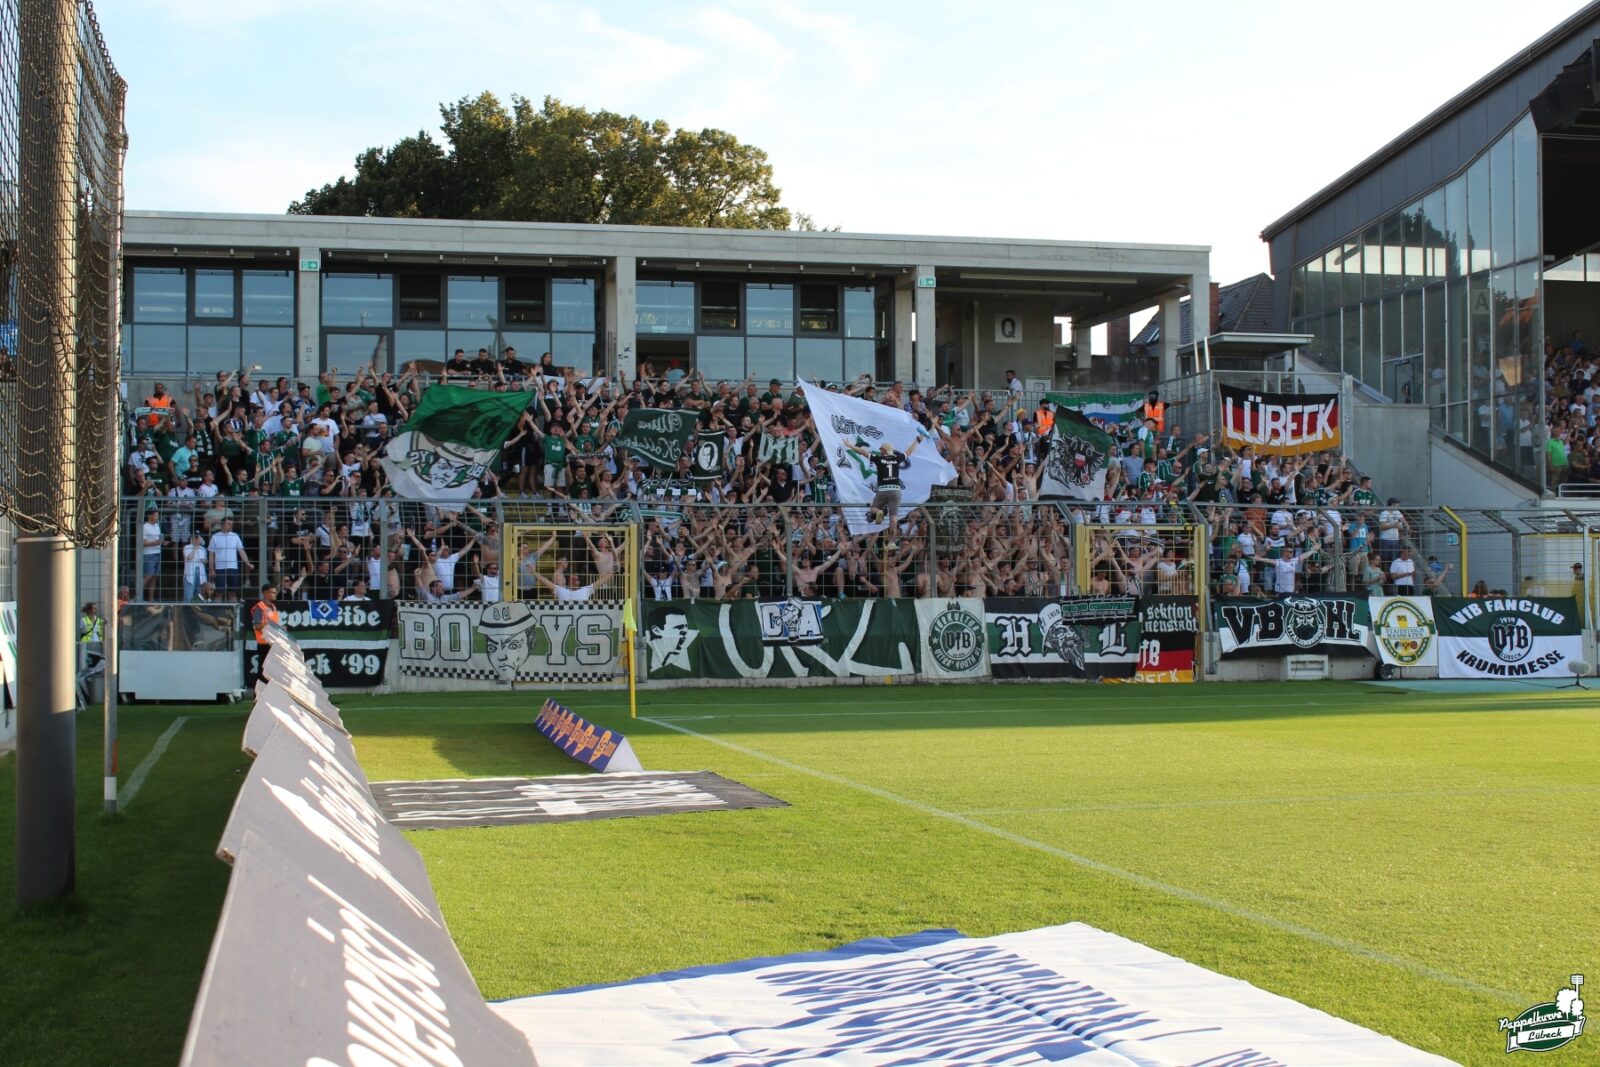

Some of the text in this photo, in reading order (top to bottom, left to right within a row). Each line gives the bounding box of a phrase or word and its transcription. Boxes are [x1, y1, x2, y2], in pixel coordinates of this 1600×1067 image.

[1000, 316, 1016, 339] Q
[1226, 394, 1335, 446] LÜBECK
[886, 463, 893, 477] 1
[1147, 602, 1193, 620] sektion
[1320, 599, 1362, 641] HL
[1449, 602, 1483, 625] VfB
[1484, 599, 1566, 625] FANCLUB
[1499, 616, 1516, 624] 1919
[1456, 649, 1566, 677] KRUMMESSE
